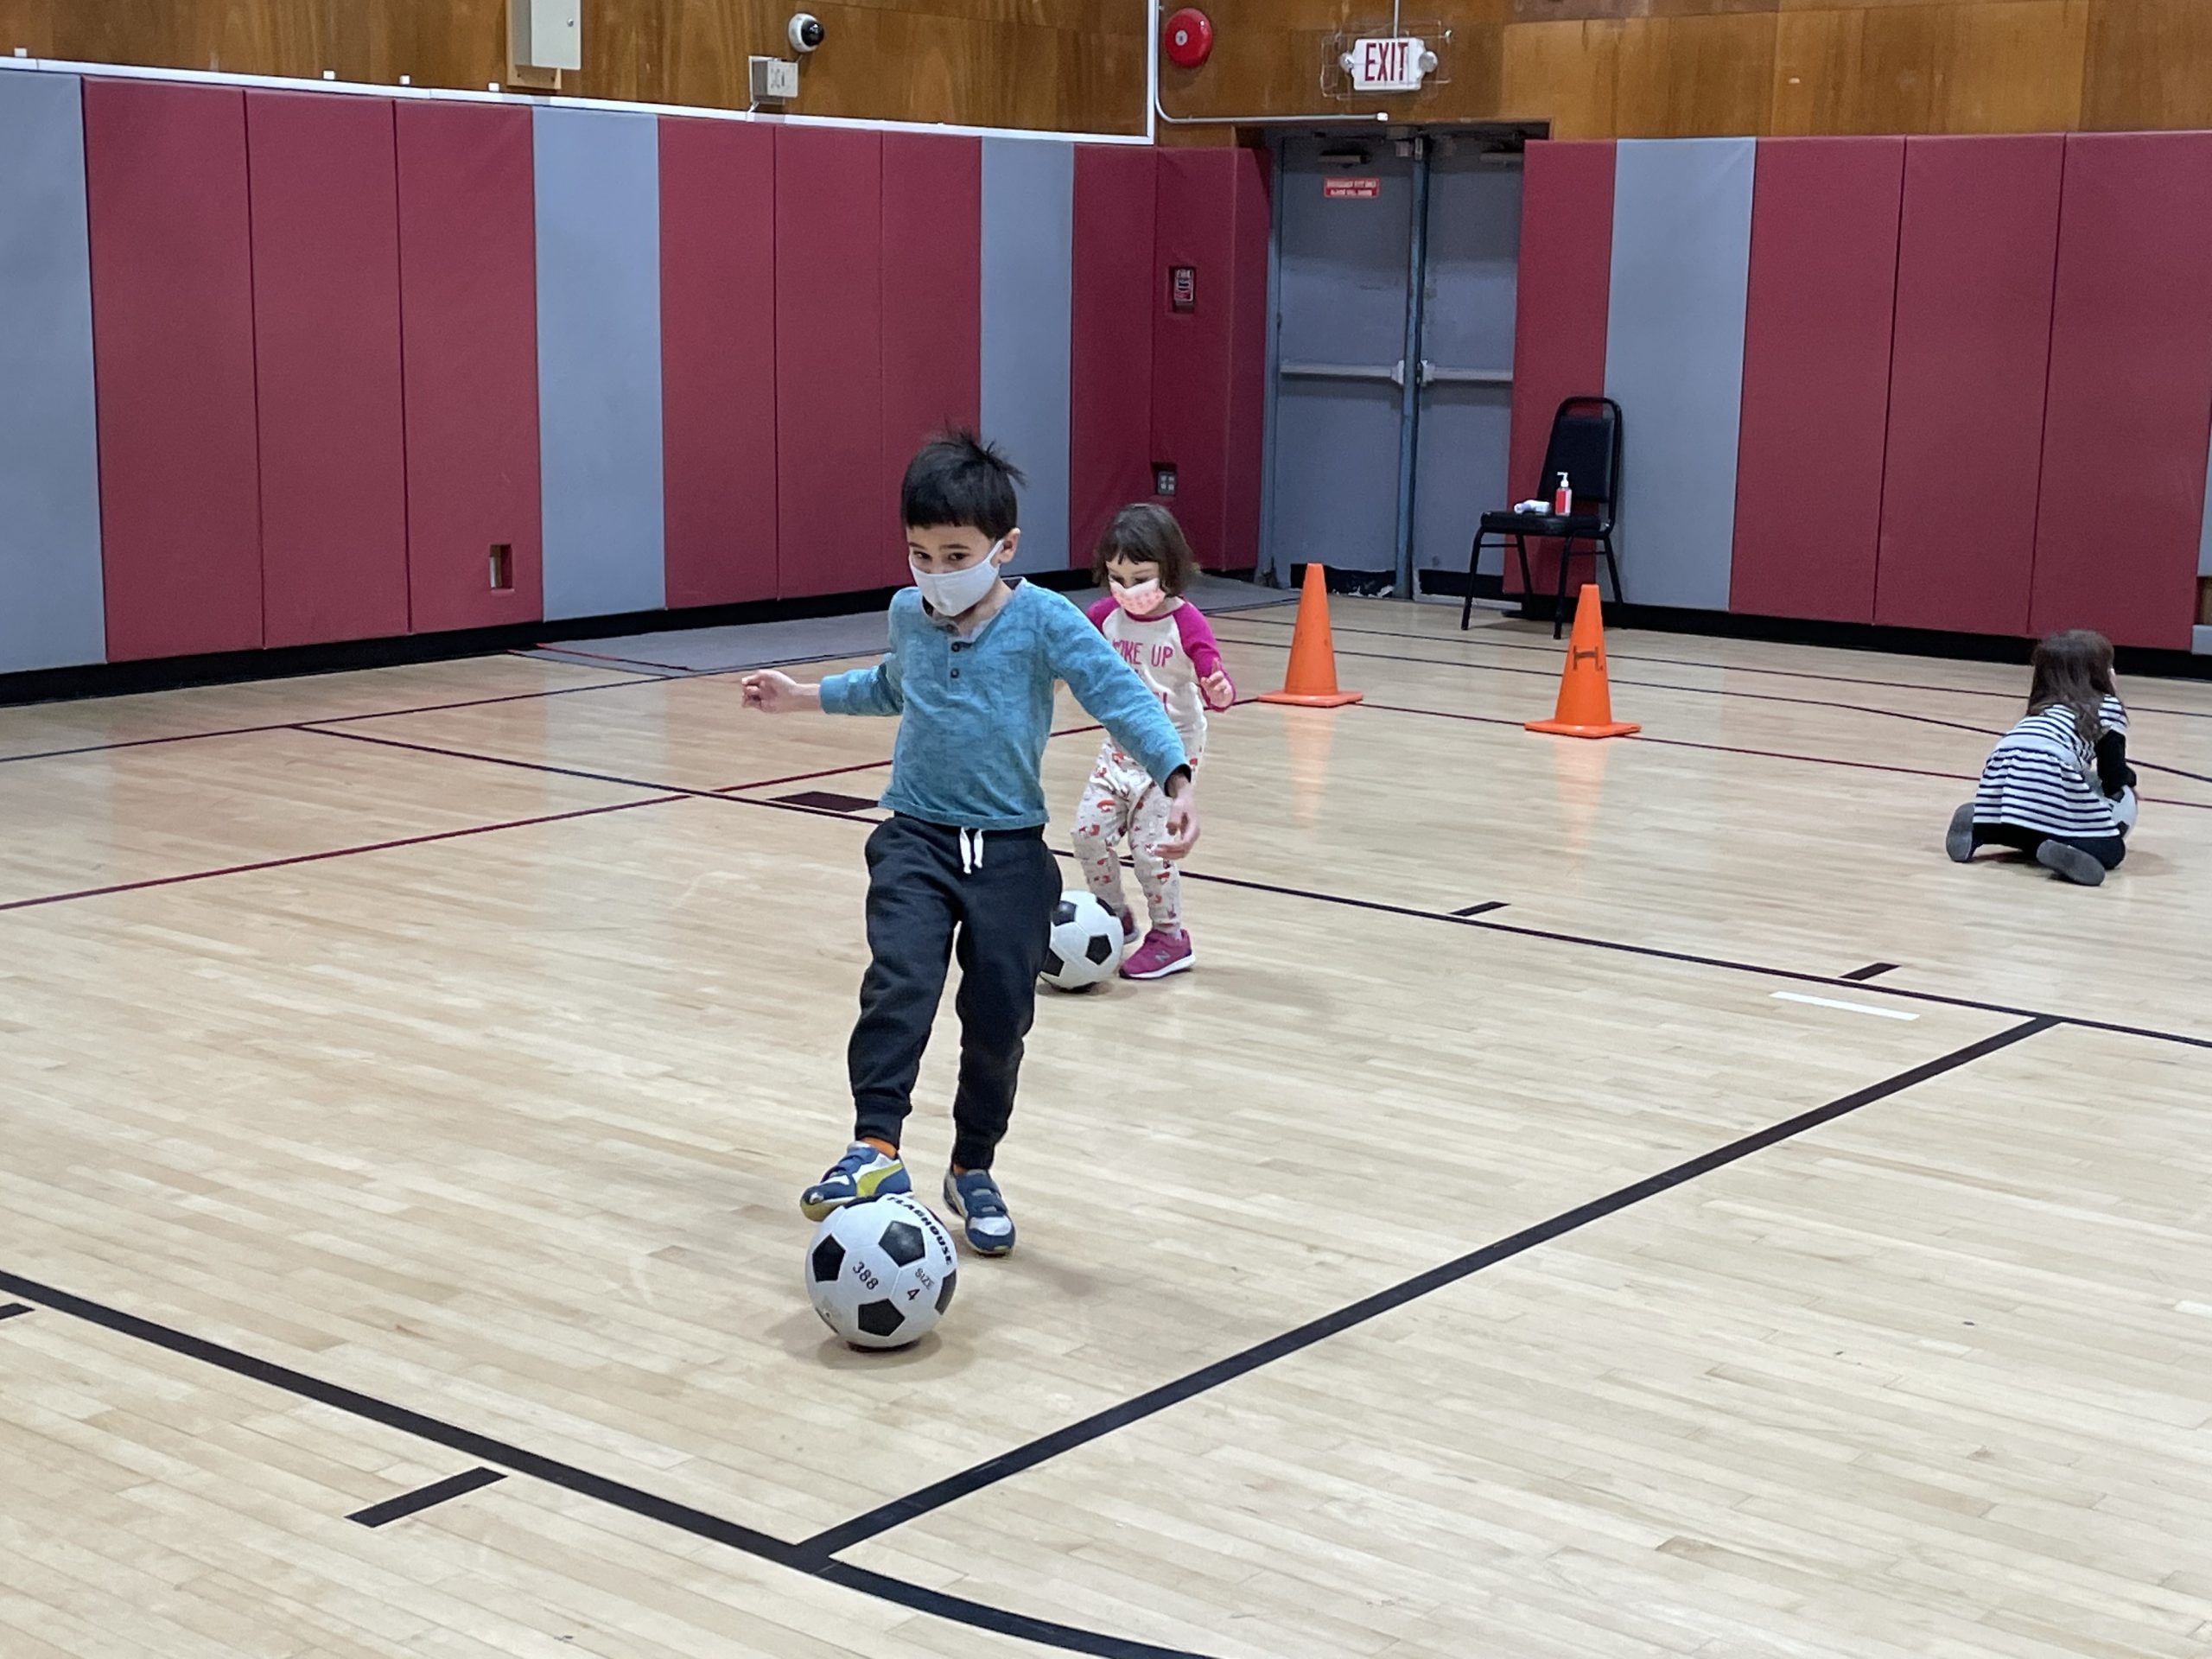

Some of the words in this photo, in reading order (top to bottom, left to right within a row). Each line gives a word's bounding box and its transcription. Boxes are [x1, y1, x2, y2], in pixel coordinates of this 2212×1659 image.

[1365, 42, 1408, 81] EXIT
[1151, 645, 1173, 667] UP
[887, 1196, 953, 1266] FLAGHOUSE
[852, 1261, 879, 1290] 388
[914, 1268, 935, 1290] SIZE
[907, 1288, 920, 1300] 4
